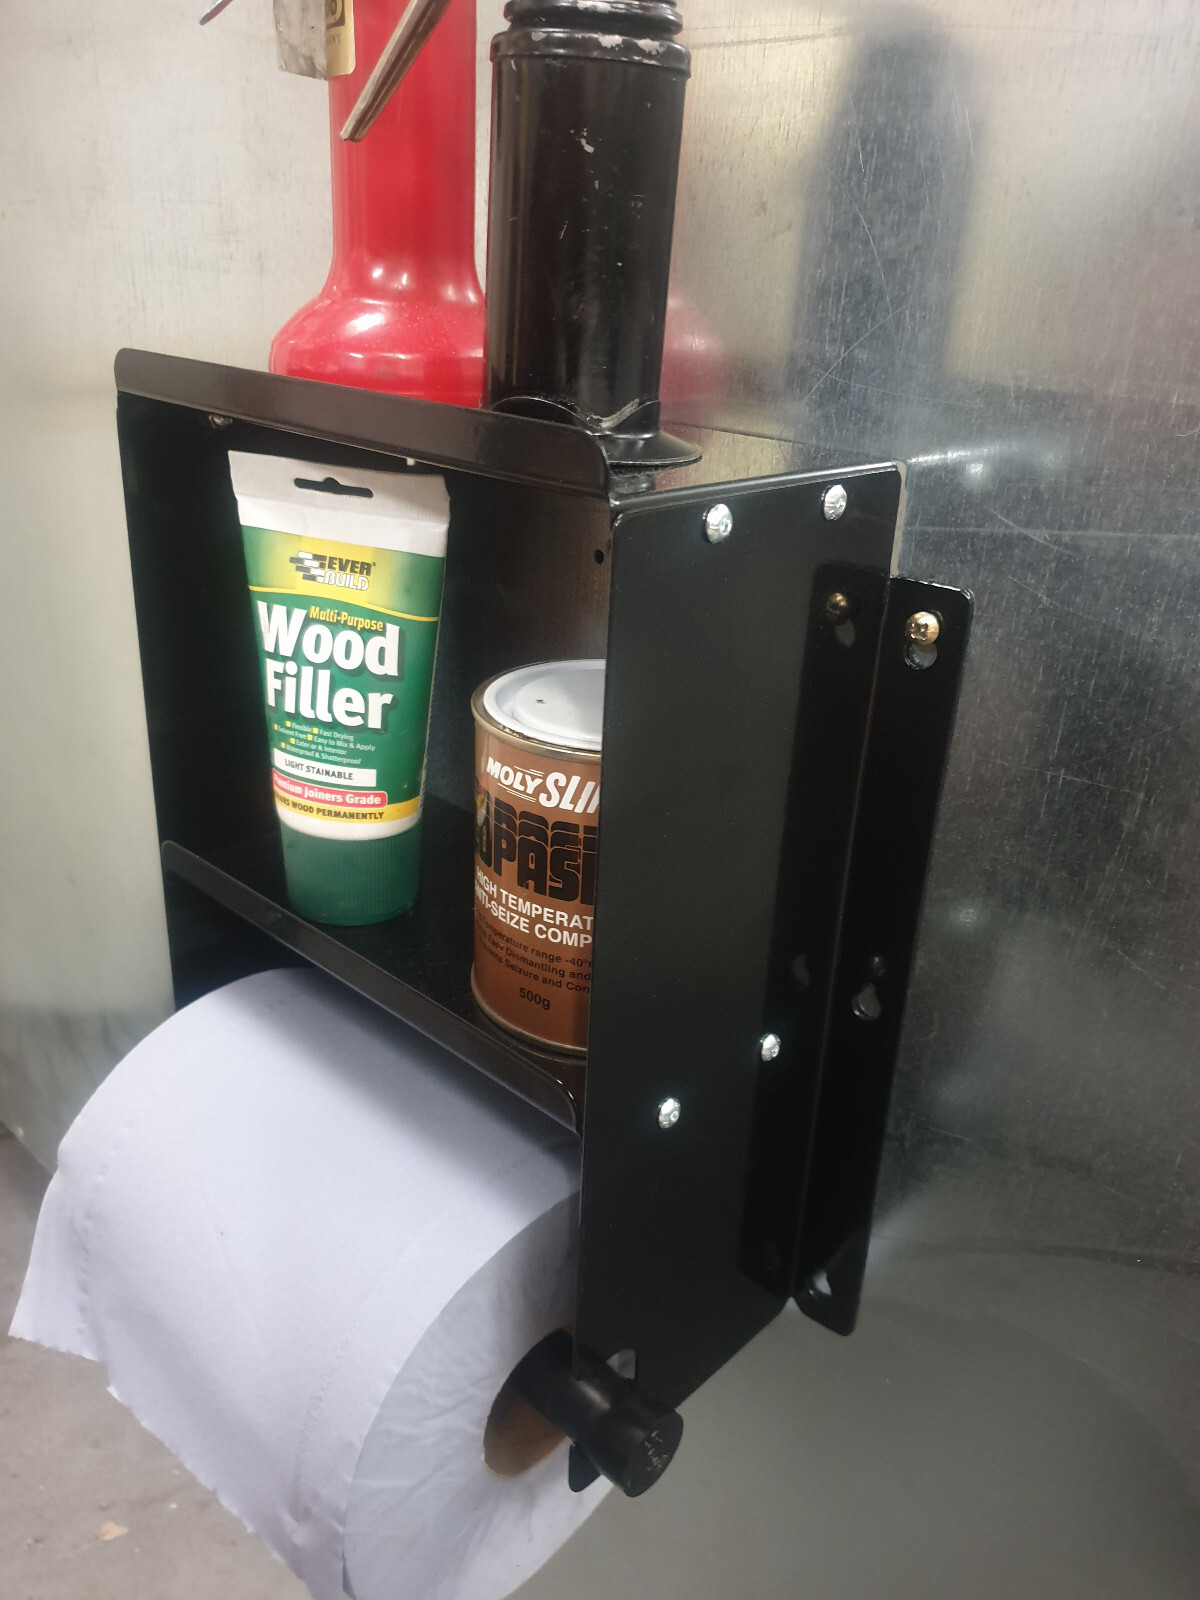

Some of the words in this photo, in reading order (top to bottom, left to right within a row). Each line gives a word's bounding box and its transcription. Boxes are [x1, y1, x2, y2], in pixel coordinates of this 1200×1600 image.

[327, 556, 372, 576] EVER
[324, 569, 369, 591] BUILD
[309, 606, 384, 632] Multi-Purpose
[257, 600, 400, 677] Wood
[266, 658, 394, 729] Filler
[284, 758, 304, 771] LIGHT
[306, 765, 354, 781] STAINABLE
[304, 786, 344, 803] Joiners
[345, 794, 381, 805] Grade
[291, 800, 315, 814] WOOD
[316, 807, 385, 820] PERMANENTLY
[476, 866, 498, 899] HIGH
[500, 888, 594, 931] TEMPERAT
[534, 923, 593, 948] COMP
[531, 948, 562, 963] range
[565, 957, 592, 967] -40°
[504, 958, 539, 982] Seizure
[542, 975, 562, 989] and
[518, 986, 552, 1011] 500g
